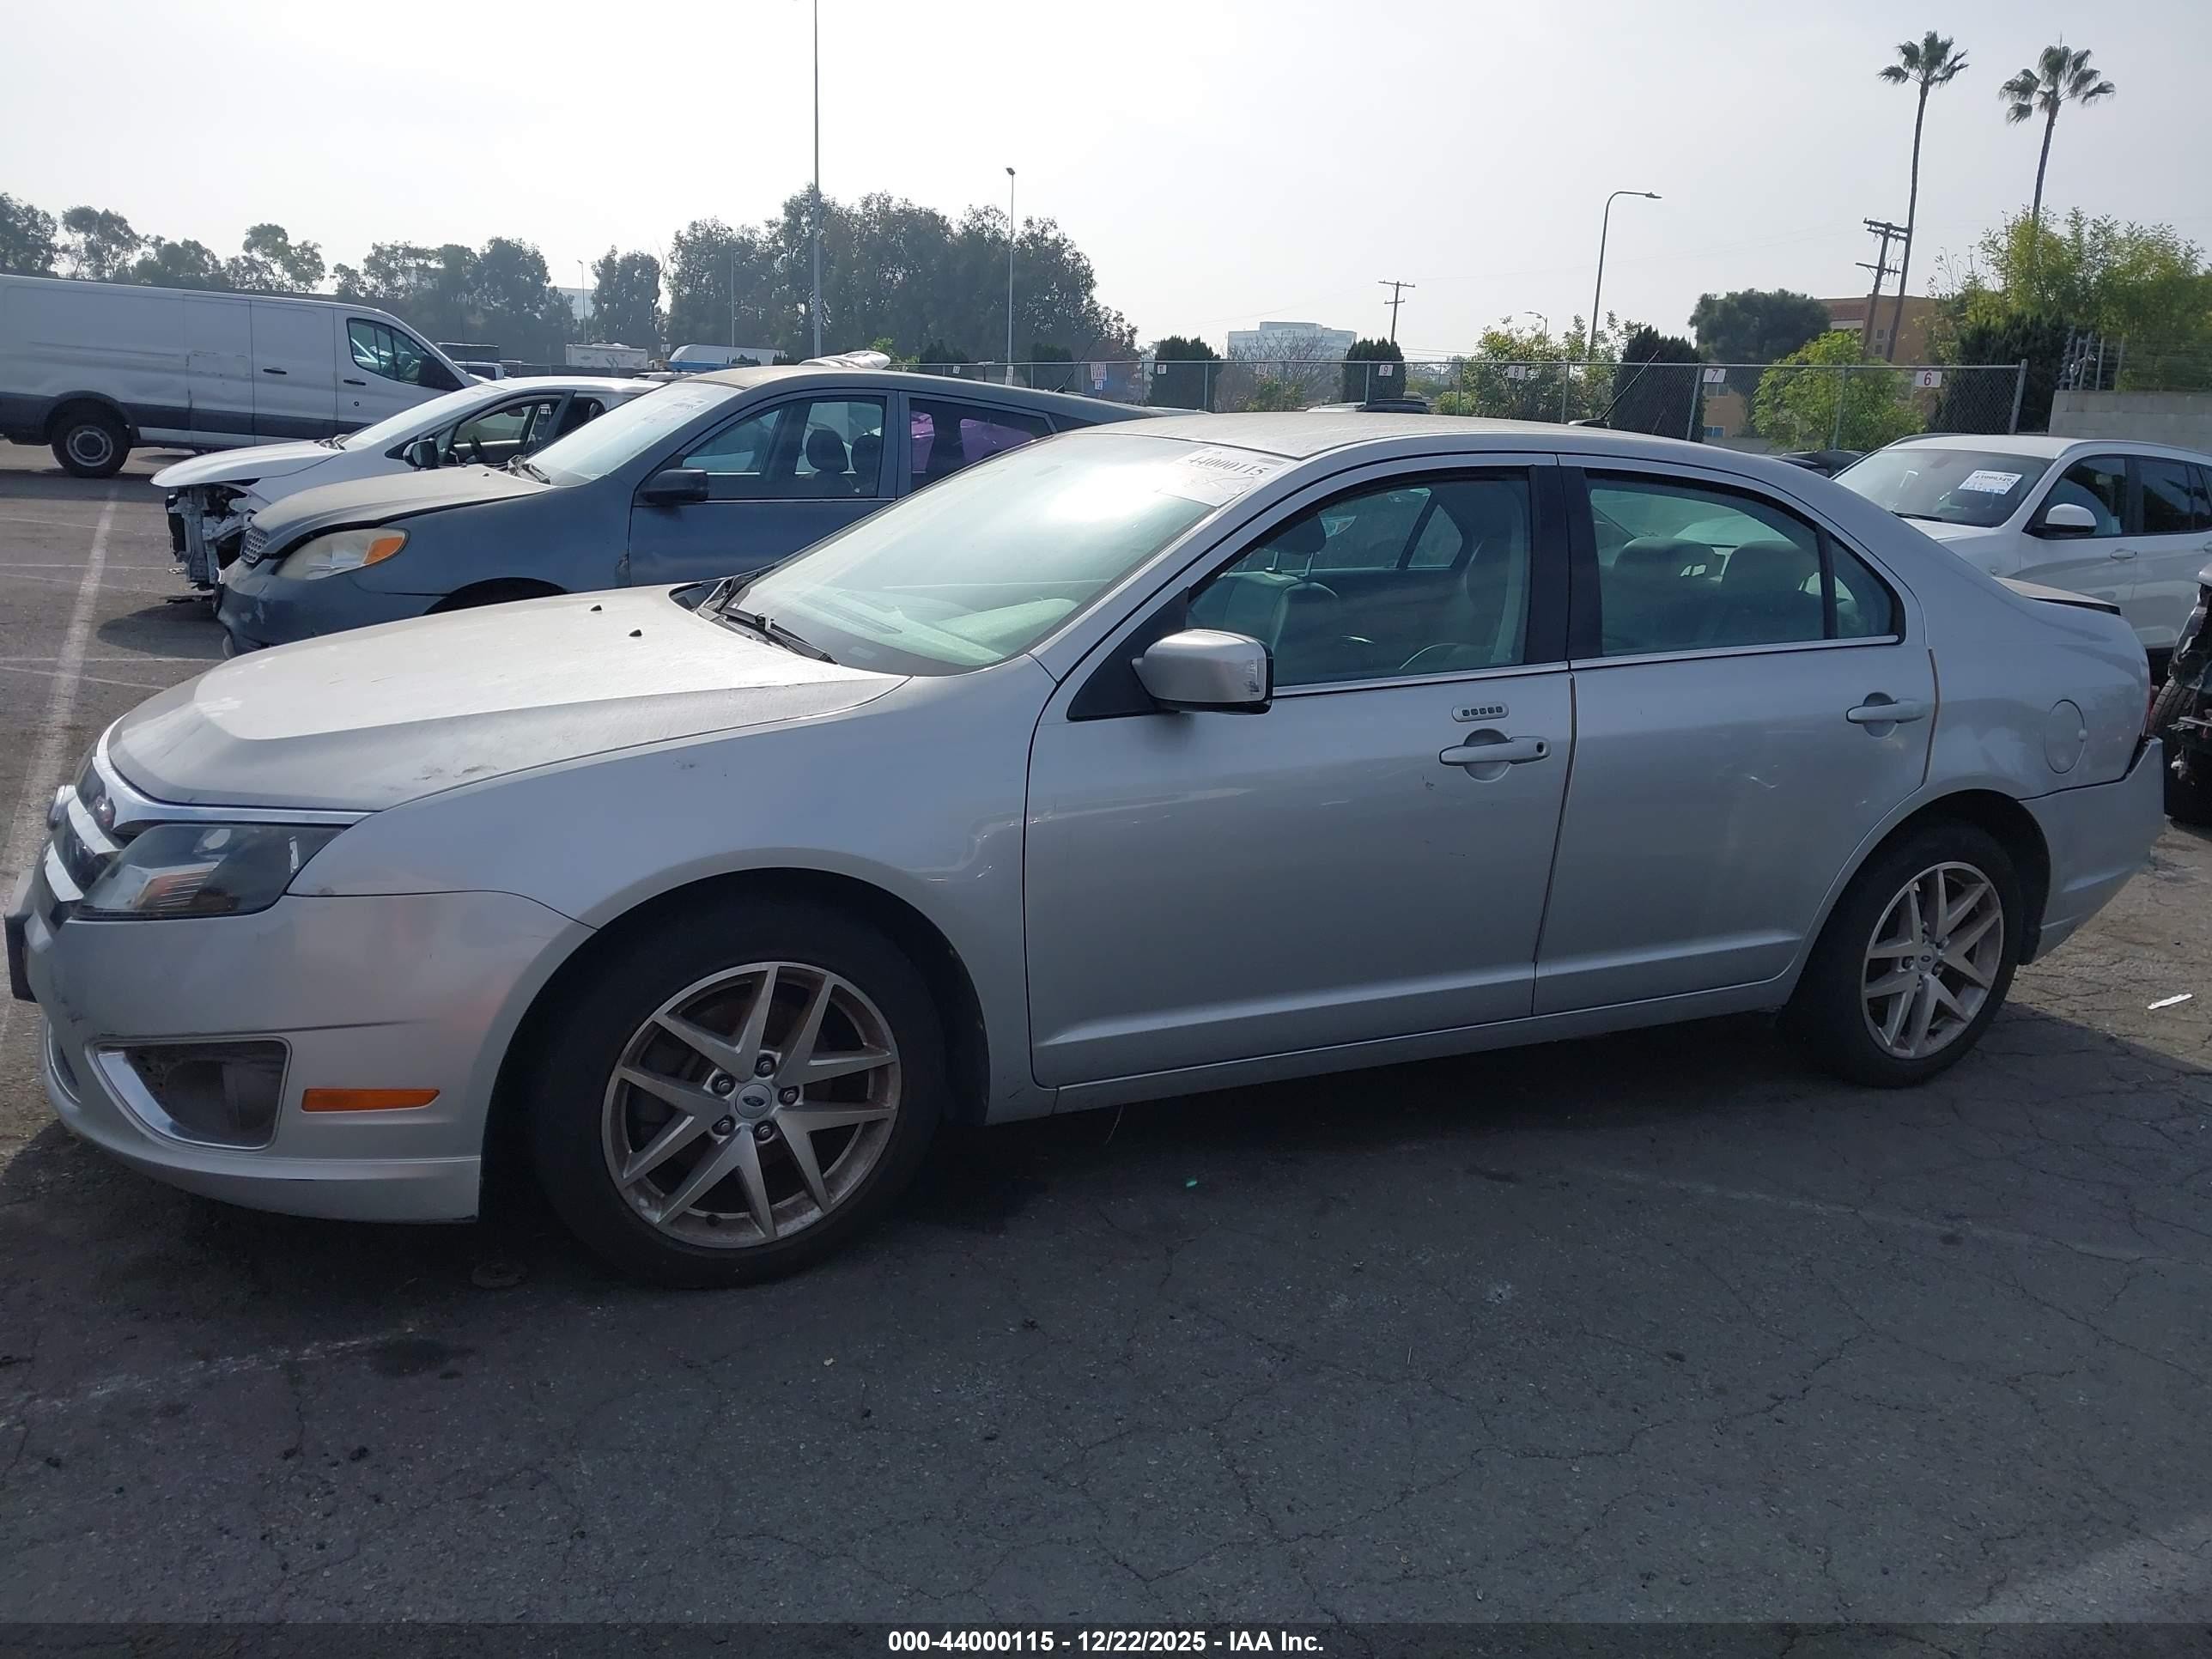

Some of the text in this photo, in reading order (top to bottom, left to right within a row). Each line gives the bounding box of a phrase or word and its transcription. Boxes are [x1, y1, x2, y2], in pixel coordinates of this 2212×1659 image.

[1514, 367, 1520, 377] 8
[1711, 369, 1719, 381] 7
[1924, 372, 1932, 386] 6
